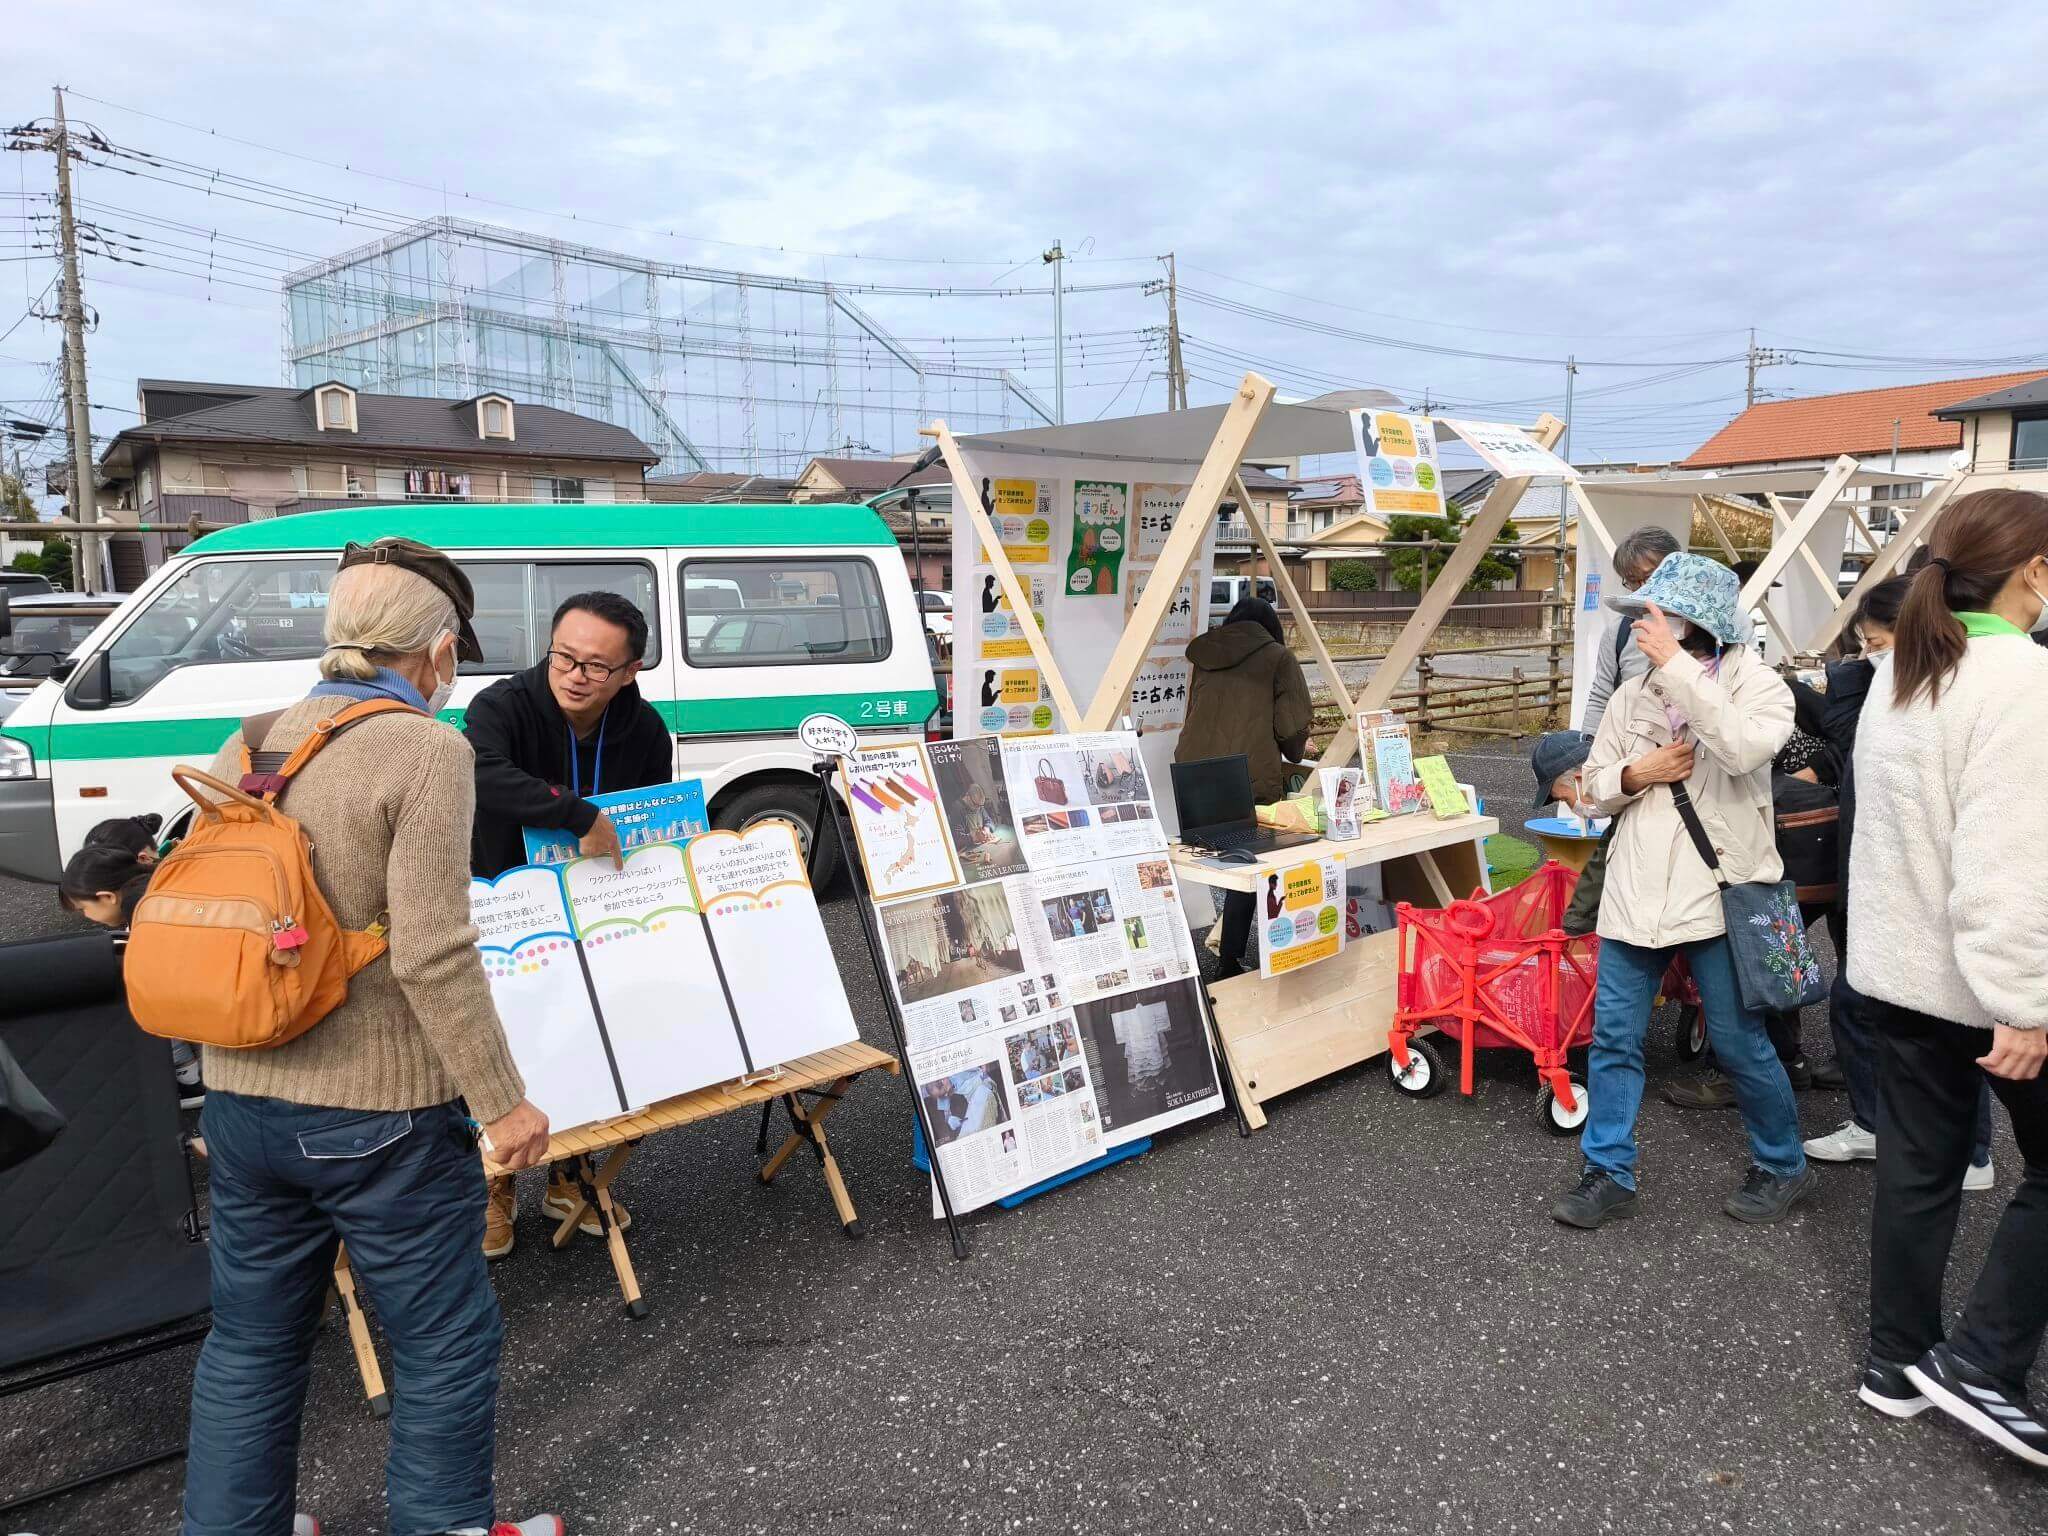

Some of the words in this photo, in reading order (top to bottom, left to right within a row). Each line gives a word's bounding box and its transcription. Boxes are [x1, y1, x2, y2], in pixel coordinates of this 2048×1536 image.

[1132, 683, 1186, 703] ミニ古本市
[860, 700, 908, 718] 2号車
[935, 744, 961, 754] SOKA
[937, 754, 962, 764] CITY
[706, 860, 789, 883] 子ども連れや友達同士でも
[572, 876, 688, 907] 色々なイベントやワークショップに
[717, 871, 785, 893] 気にせず行けるところ
[471, 889, 531, 909] 館はやっぱり！
[603, 892, 664, 912] 参加できるところ
